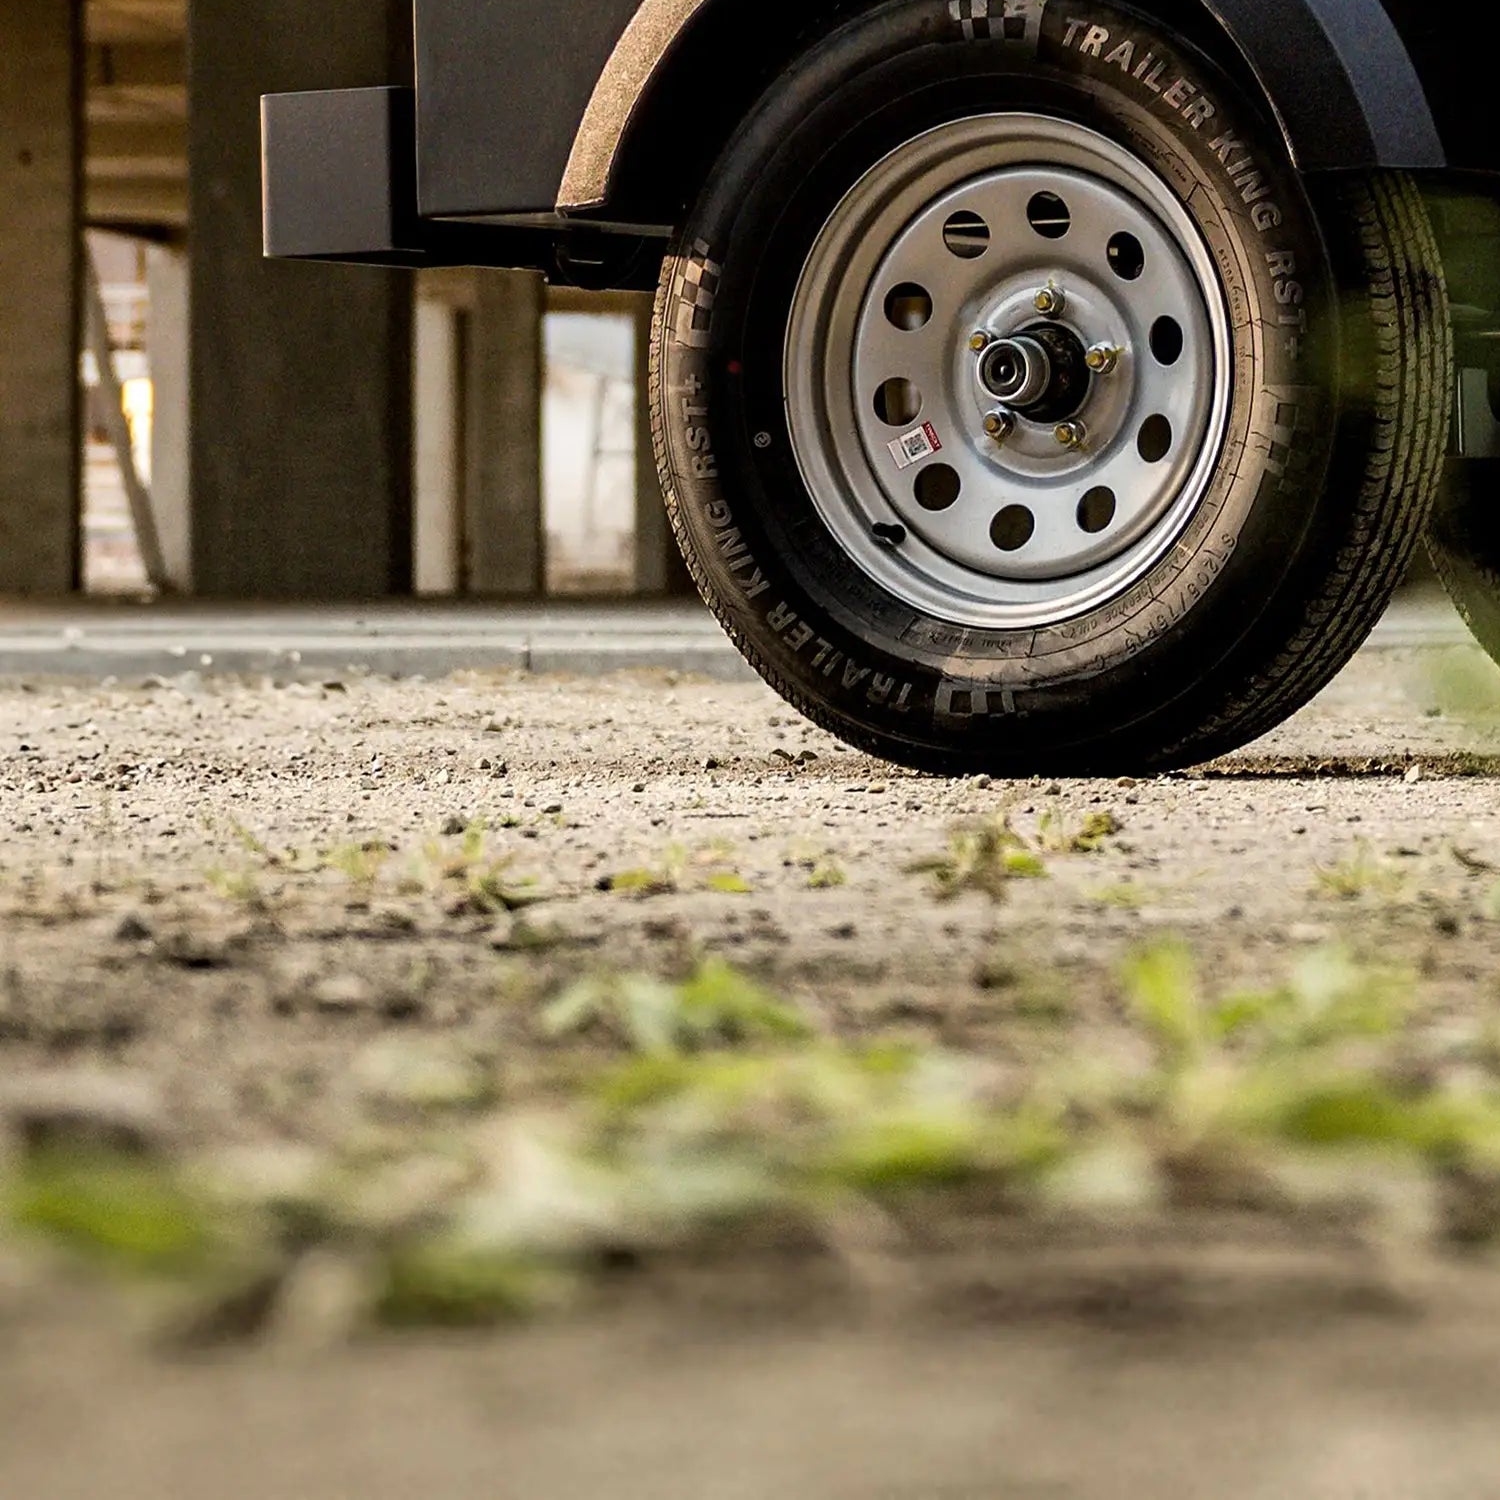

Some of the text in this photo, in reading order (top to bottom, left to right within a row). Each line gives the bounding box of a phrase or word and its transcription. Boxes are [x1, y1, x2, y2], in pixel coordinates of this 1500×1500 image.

[1060, 15, 1217, 130] TRAILER
[1208, 127, 1283, 232] KING
[681, 373, 721, 479] RST+
[703, 498, 771, 600] KING
[765, 600, 914, 713] TRAILER
